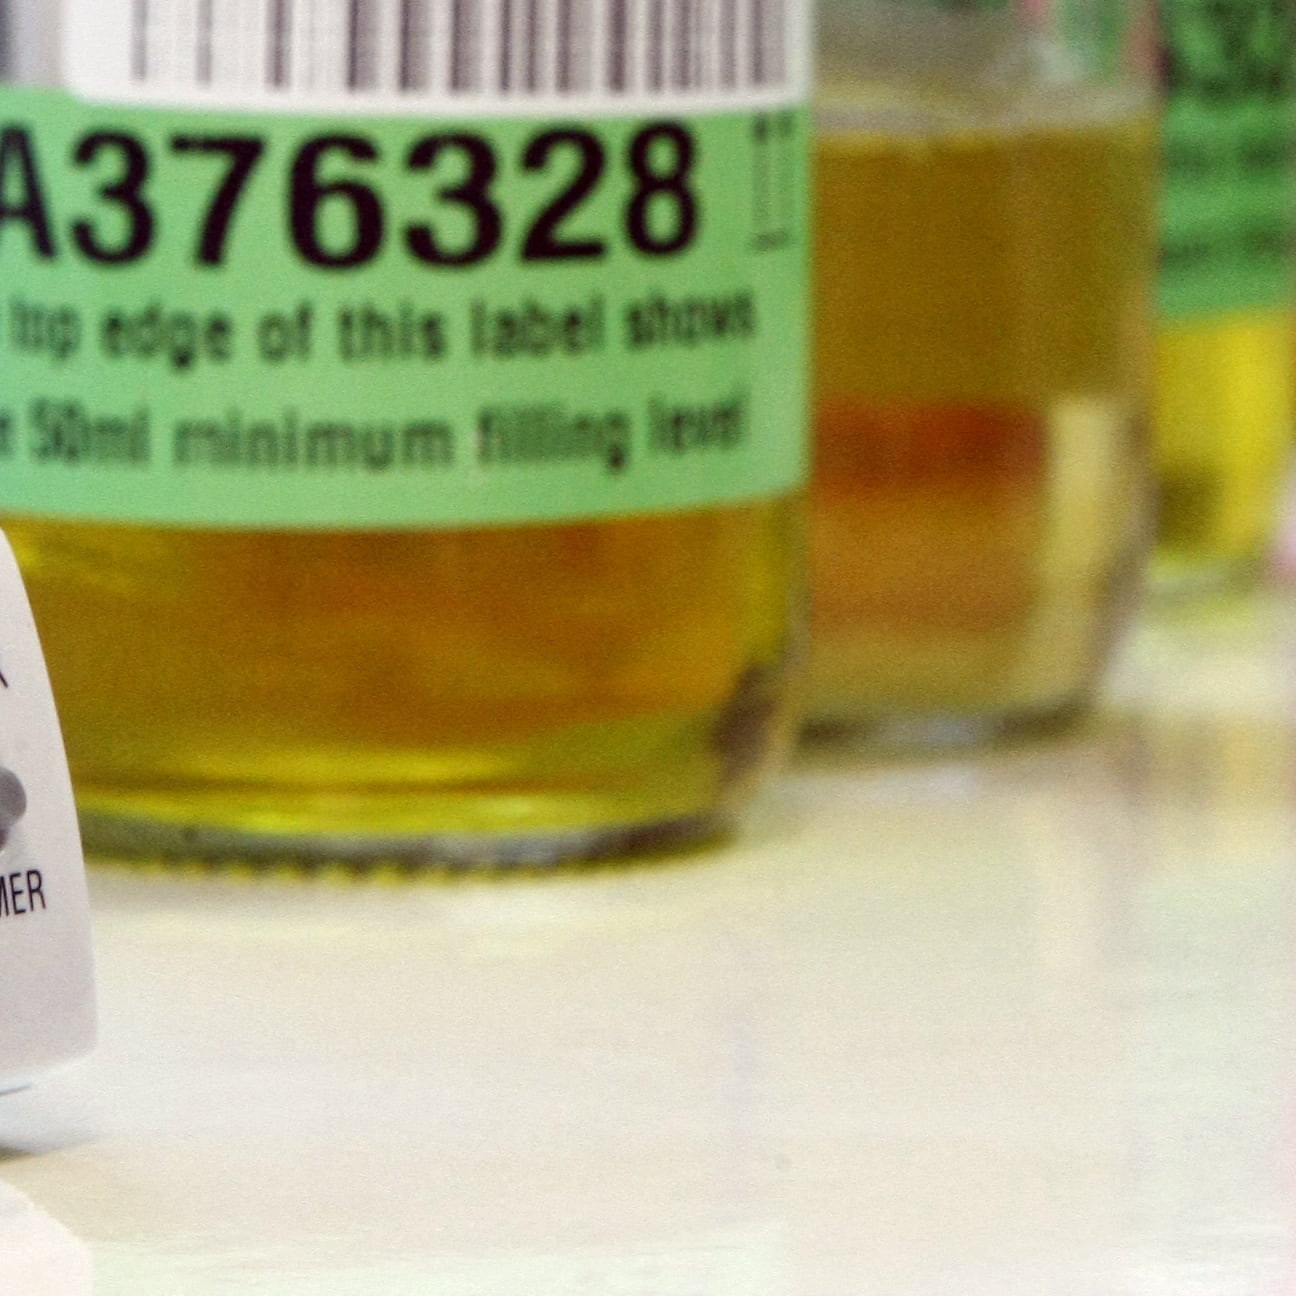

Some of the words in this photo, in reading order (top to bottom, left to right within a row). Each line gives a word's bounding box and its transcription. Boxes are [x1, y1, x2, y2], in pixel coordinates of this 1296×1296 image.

[100, 301, 232, 375] edge
[257, 301, 313, 365] of
[338, 297, 447, 363] this
[470, 293, 604, 361] label
[172, 406, 455, 471] minimum
